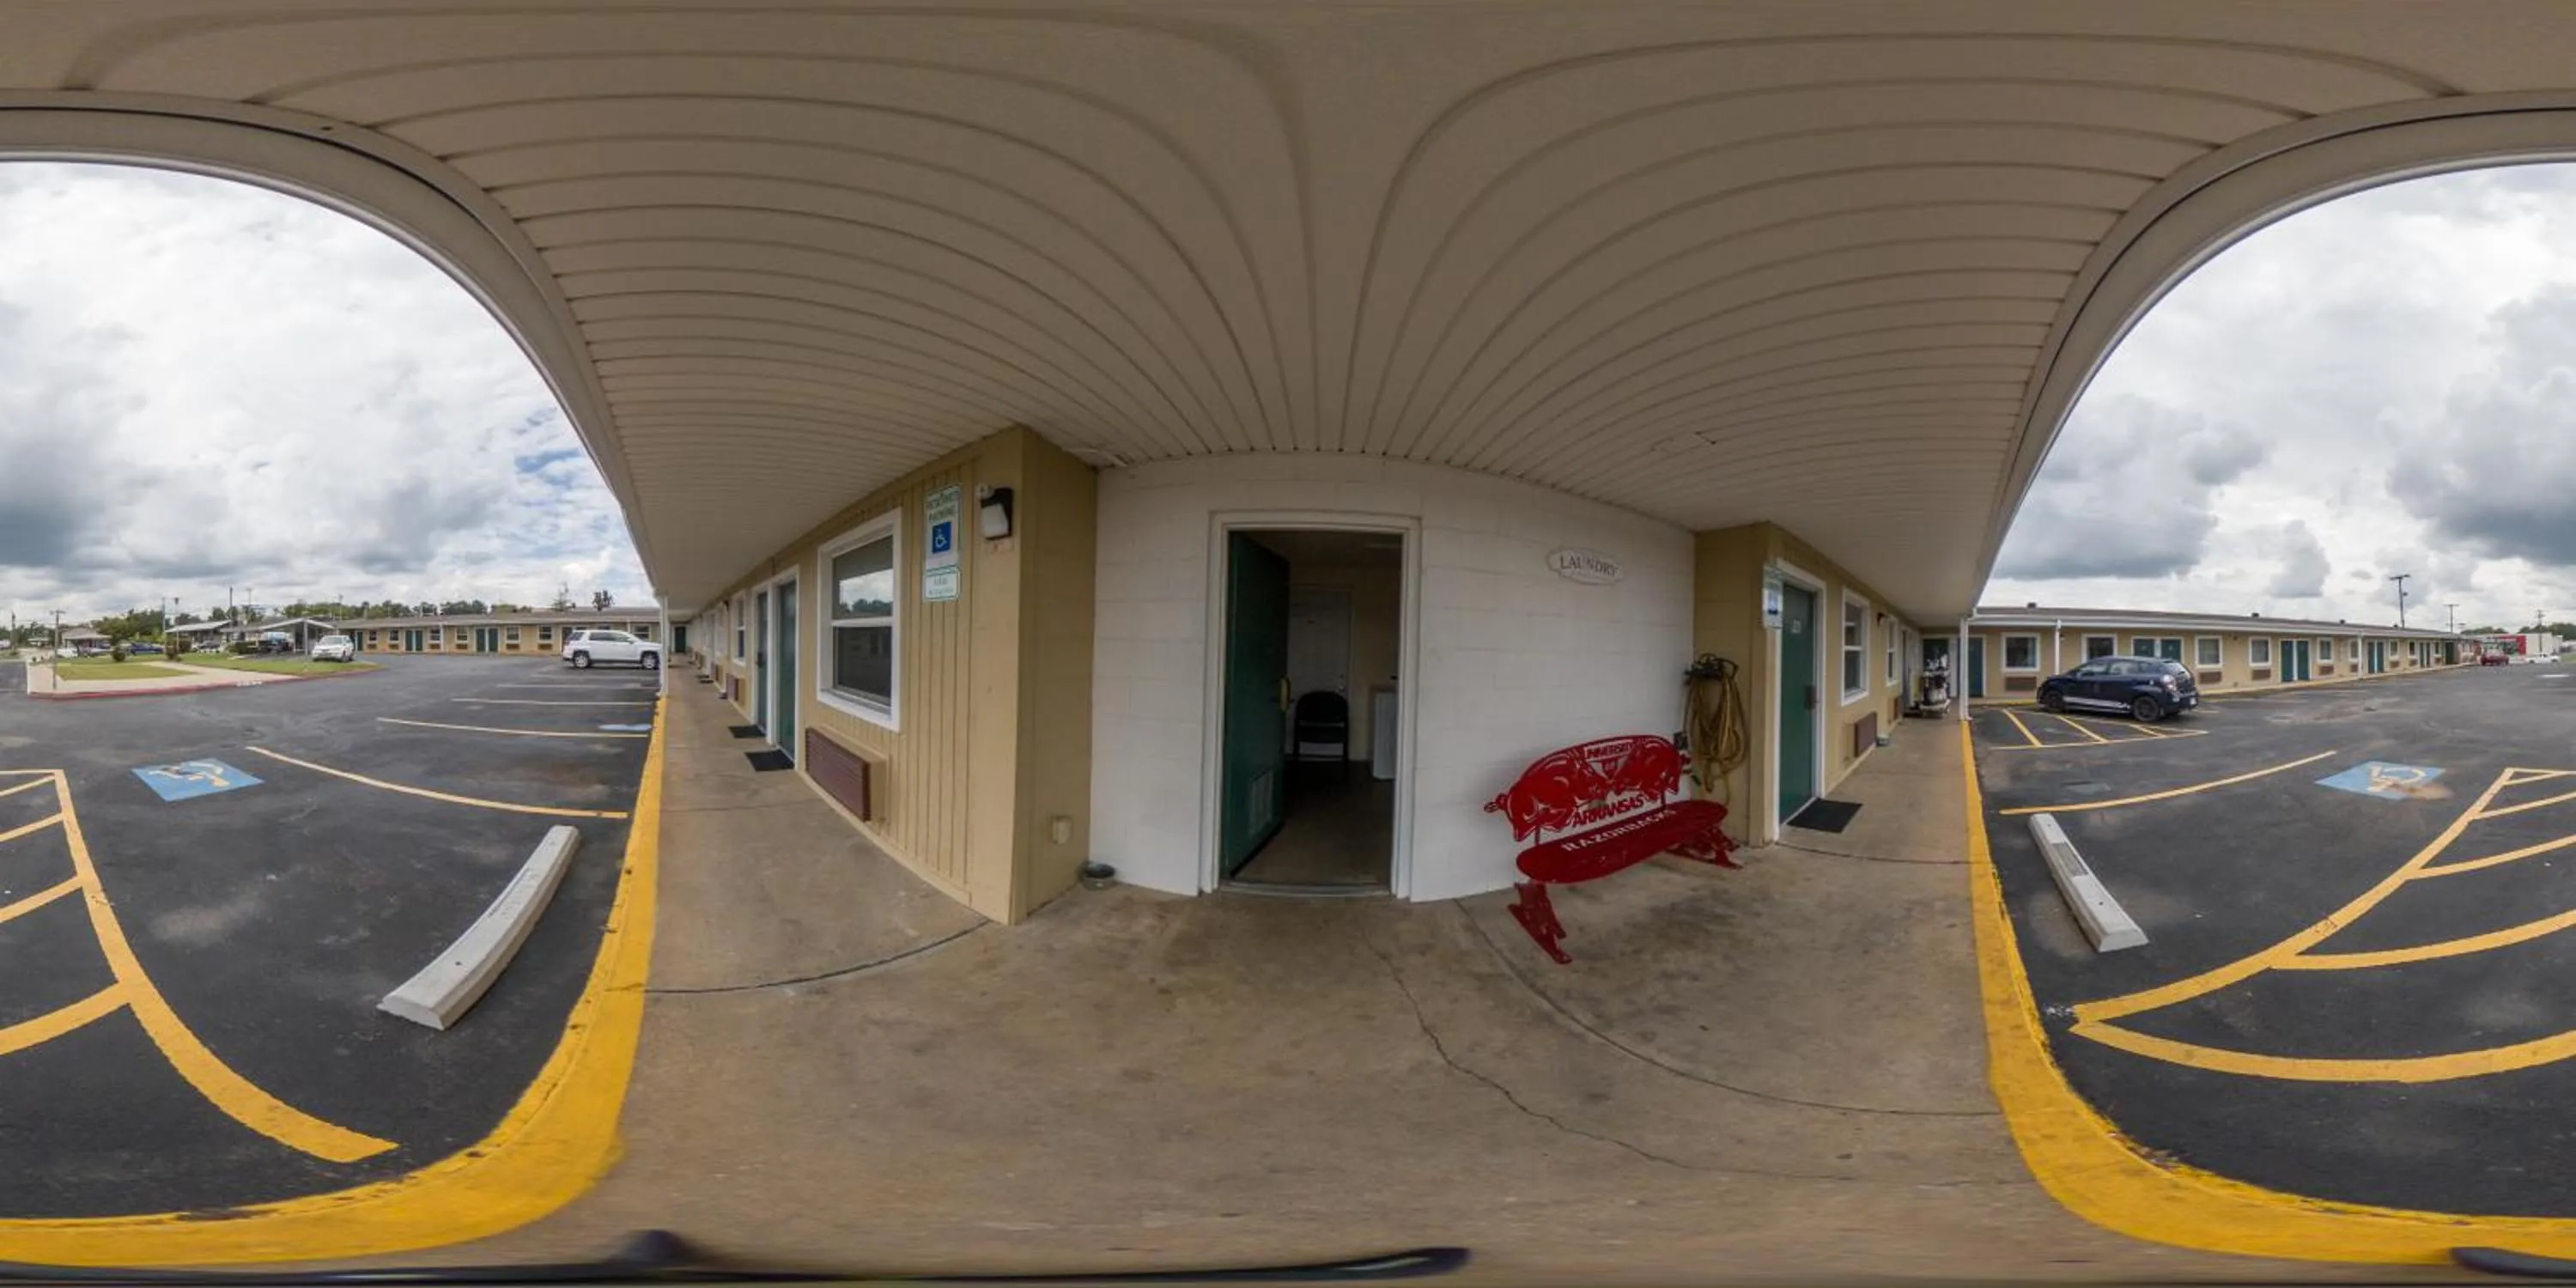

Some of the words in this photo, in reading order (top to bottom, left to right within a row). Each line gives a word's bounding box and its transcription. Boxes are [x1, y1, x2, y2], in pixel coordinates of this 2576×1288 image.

[1559, 555, 1619, 577] LAUNDRY
[1571, 795, 1644, 828] ARKANSAS
[1560, 809, 1677, 852] RAZORBACKS
